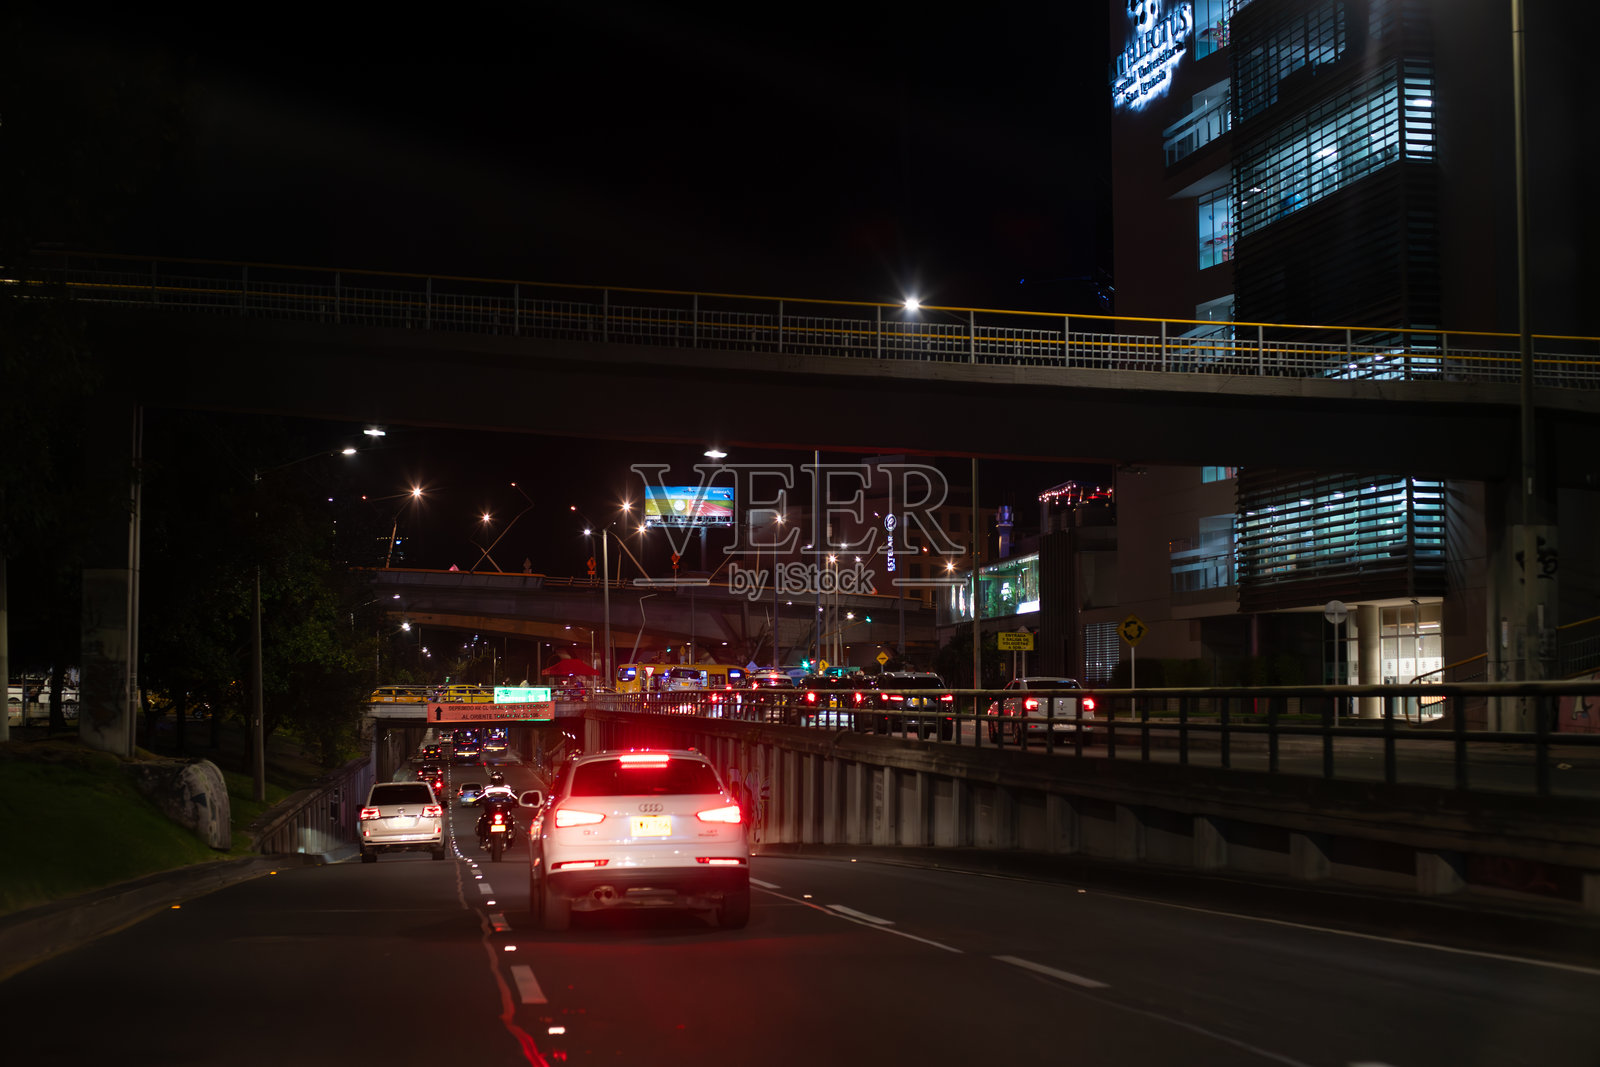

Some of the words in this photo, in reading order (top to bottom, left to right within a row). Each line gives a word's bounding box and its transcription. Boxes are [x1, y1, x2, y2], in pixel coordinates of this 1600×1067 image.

[1110, 70, 1136, 97] Hospital
[1138, 41, 1186, 78] Universitario
[1126, 89, 1139, 104] San
[1140, 70, 1167, 95] Ignacio
